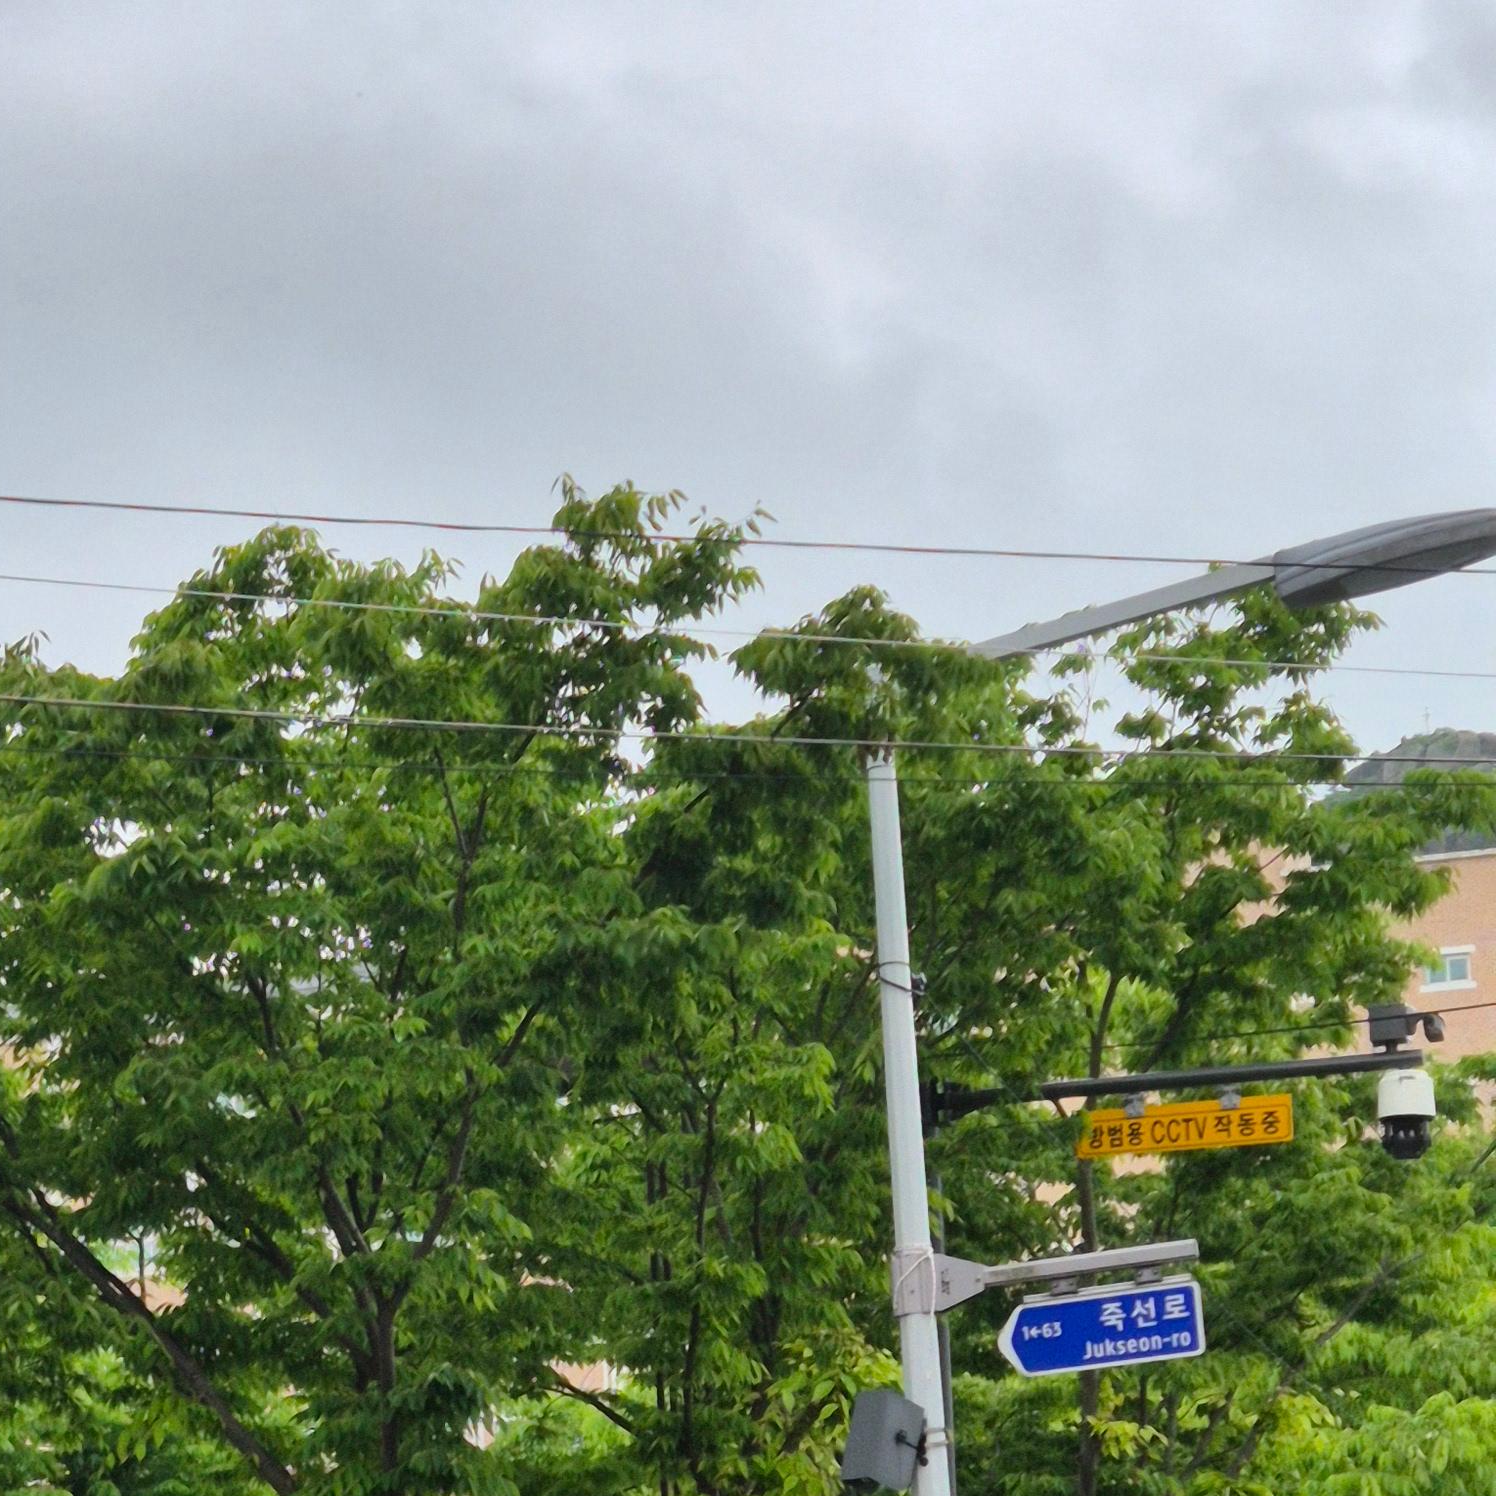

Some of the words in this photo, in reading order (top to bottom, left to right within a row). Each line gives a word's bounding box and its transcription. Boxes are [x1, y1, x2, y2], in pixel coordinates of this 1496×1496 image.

[1151, 1117, 1208, 1145] CCTV
[1214, 1110, 1280, 1138] 작동중
[1099, 1293, 1191, 1332] 죽선로
[1082, 1331, 1192, 1360] Jukseon-ro
